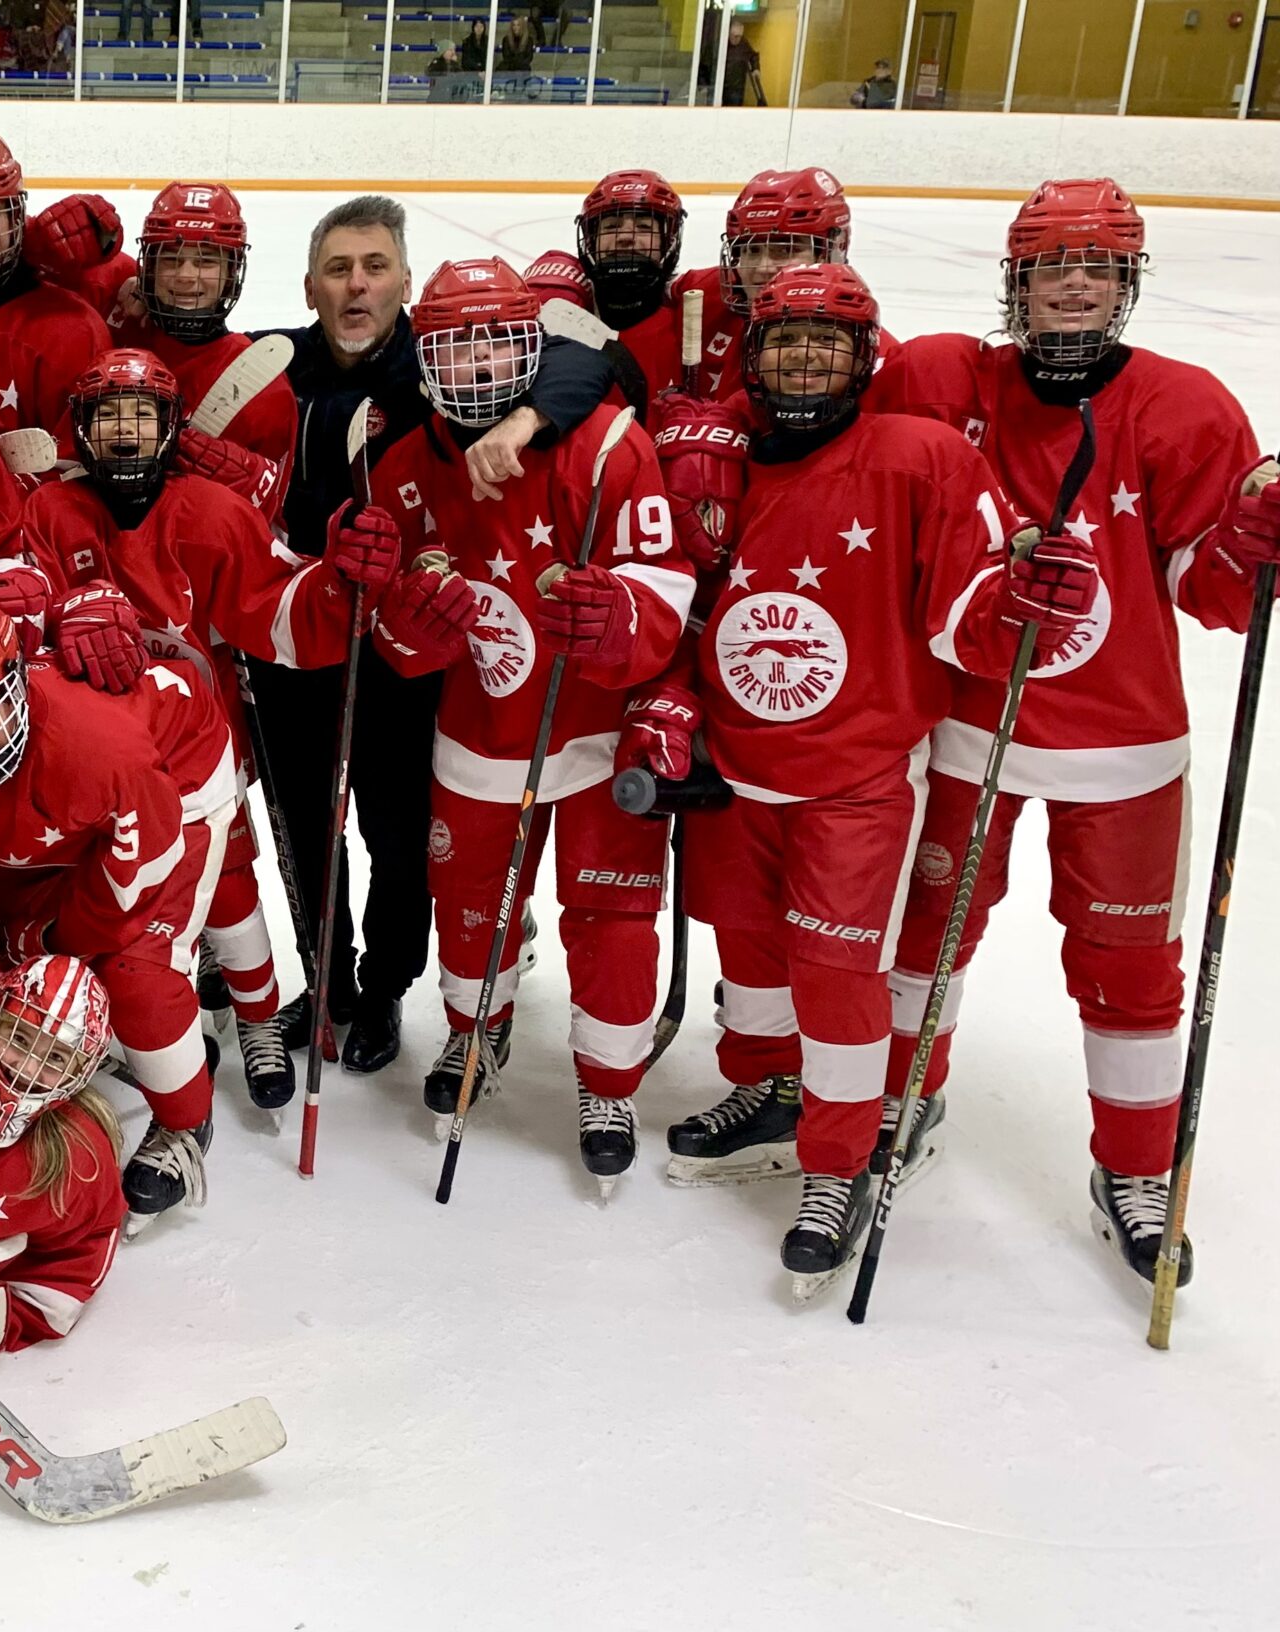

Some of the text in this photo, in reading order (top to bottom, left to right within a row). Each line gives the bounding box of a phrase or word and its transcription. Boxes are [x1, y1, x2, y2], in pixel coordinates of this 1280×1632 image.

[611, 183, 649, 192] CCM
[184, 191, 213, 209] 12
[175, 219, 215, 229] CCM
[746, 209, 780, 219] CCM
[467, 269, 488, 282] 19
[786, 287, 826, 297] CCM
[460, 303, 502, 314] BAUER
[1035, 370, 1088, 382] CCM
[653, 423, 751, 452] BAUER
[612, 494, 674, 556] 19
[750, 604, 799, 632] SOO
[768, 662, 790, 684] JR.
[729, 663, 835, 712] GREYHOUNDS
[623, 698, 695, 722] UER
[110, 811, 140, 861] 5
[575, 868, 662, 889] BAUER
[498, 865, 518, 921] BAUER
[1088, 901, 1172, 917] BAUER
[784, 908, 881, 945] BAUER
[1204, 951, 1222, 1013] BAUER
[913, 1022, 935, 1087] TACKS
[876, 1152, 904, 1232] CCM
[1173, 1166, 1190, 1241] HAVOK
